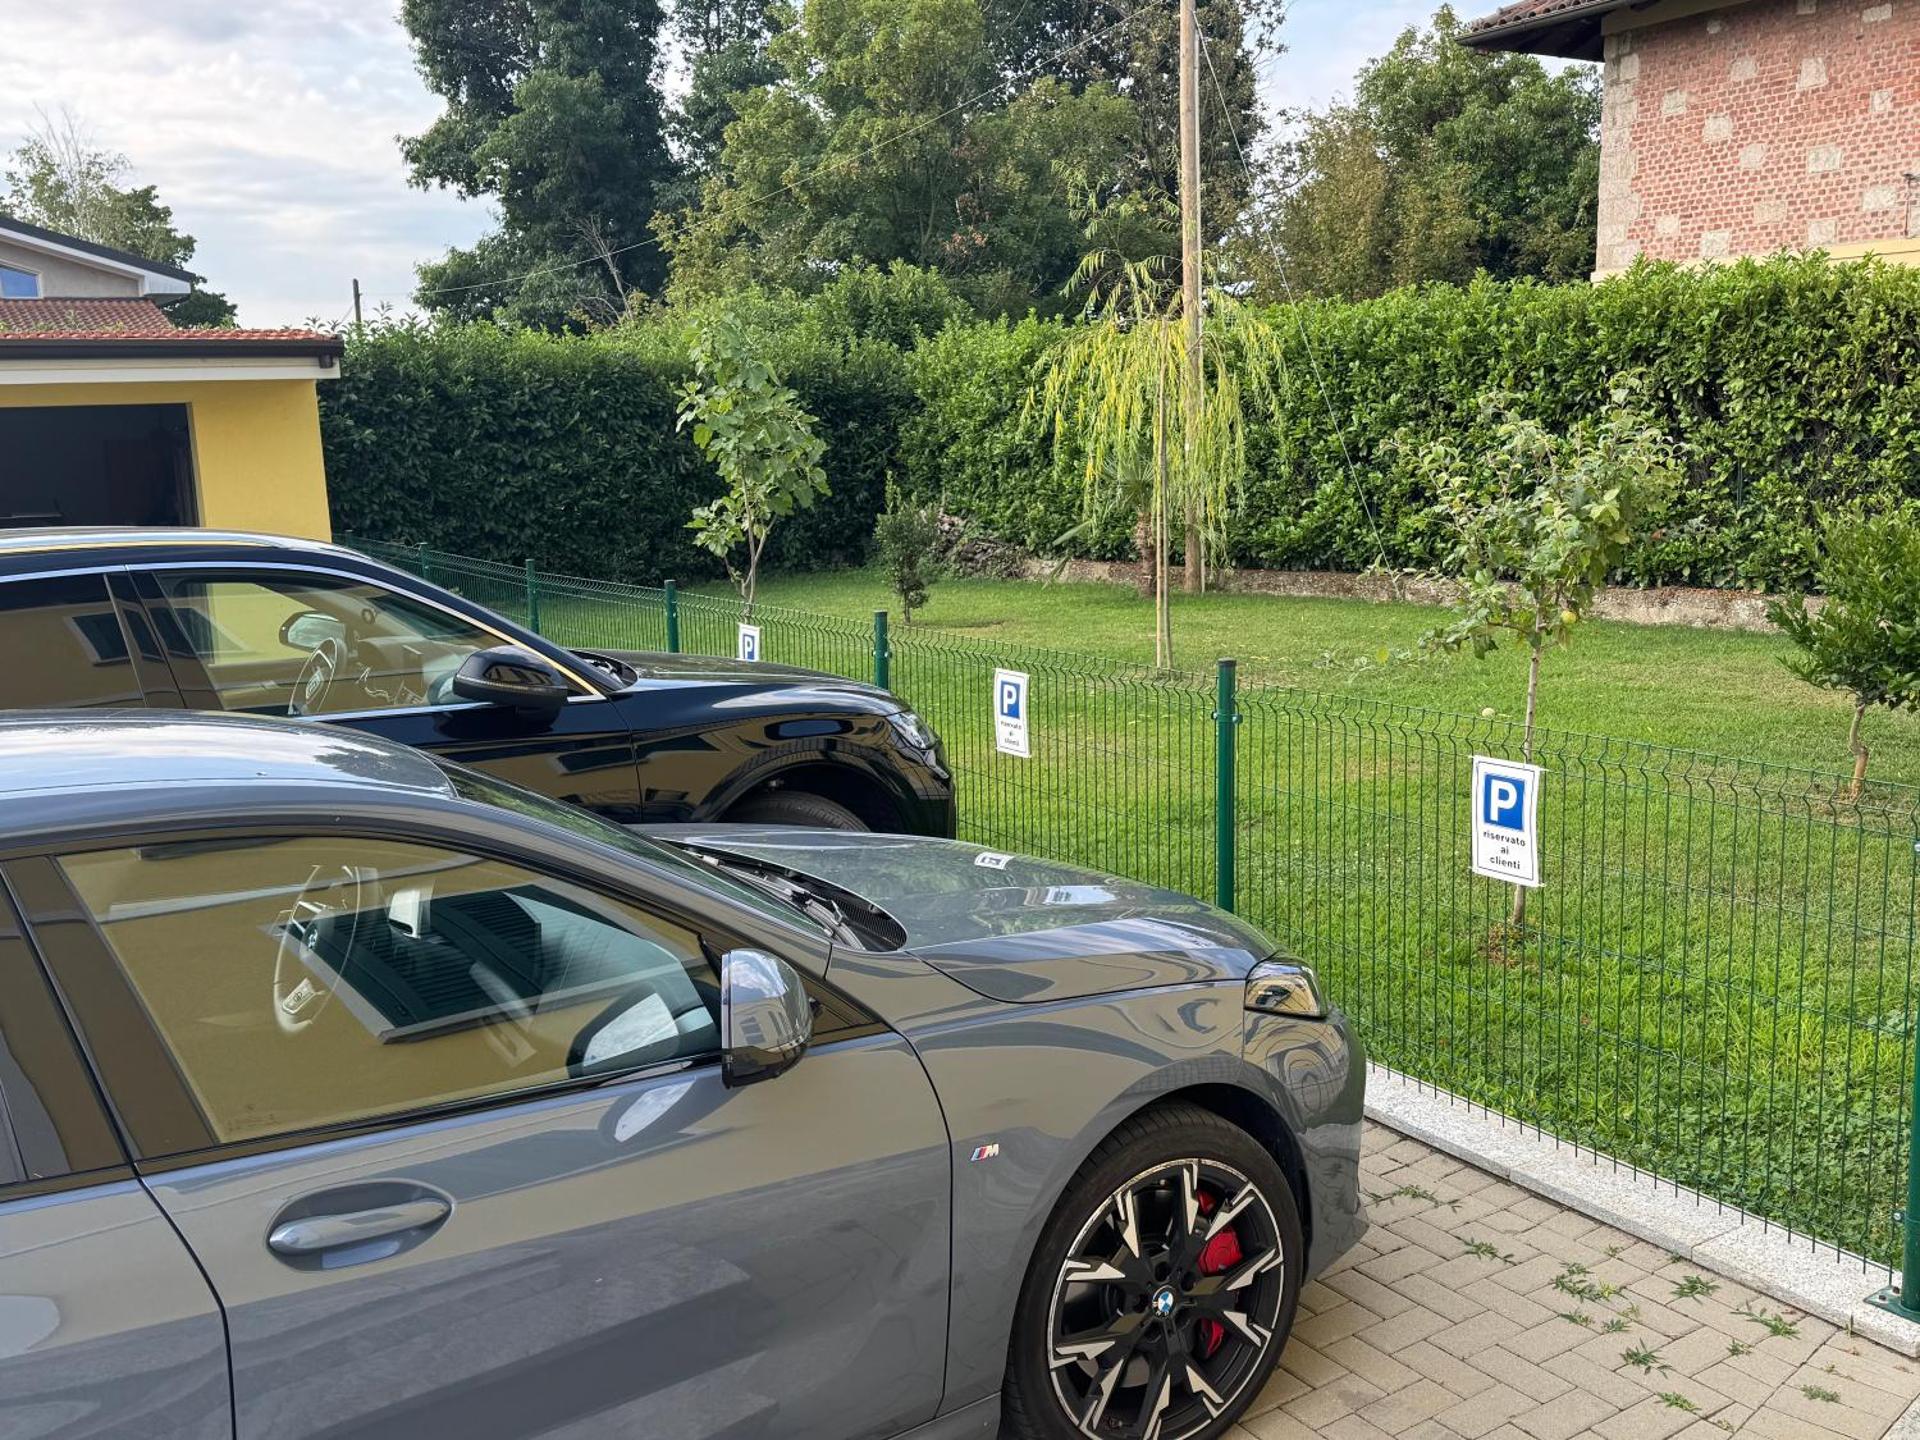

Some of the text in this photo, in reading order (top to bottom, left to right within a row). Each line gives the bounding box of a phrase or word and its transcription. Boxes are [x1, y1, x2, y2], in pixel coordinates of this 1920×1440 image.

[745, 635, 753, 659] P
[1003, 684, 1017, 714] P
[1489, 779, 1518, 822] P
[1483, 830, 1526, 847] riservato
[1500, 845, 1509, 854] ai
[1489, 856, 1521, 870] clienti
